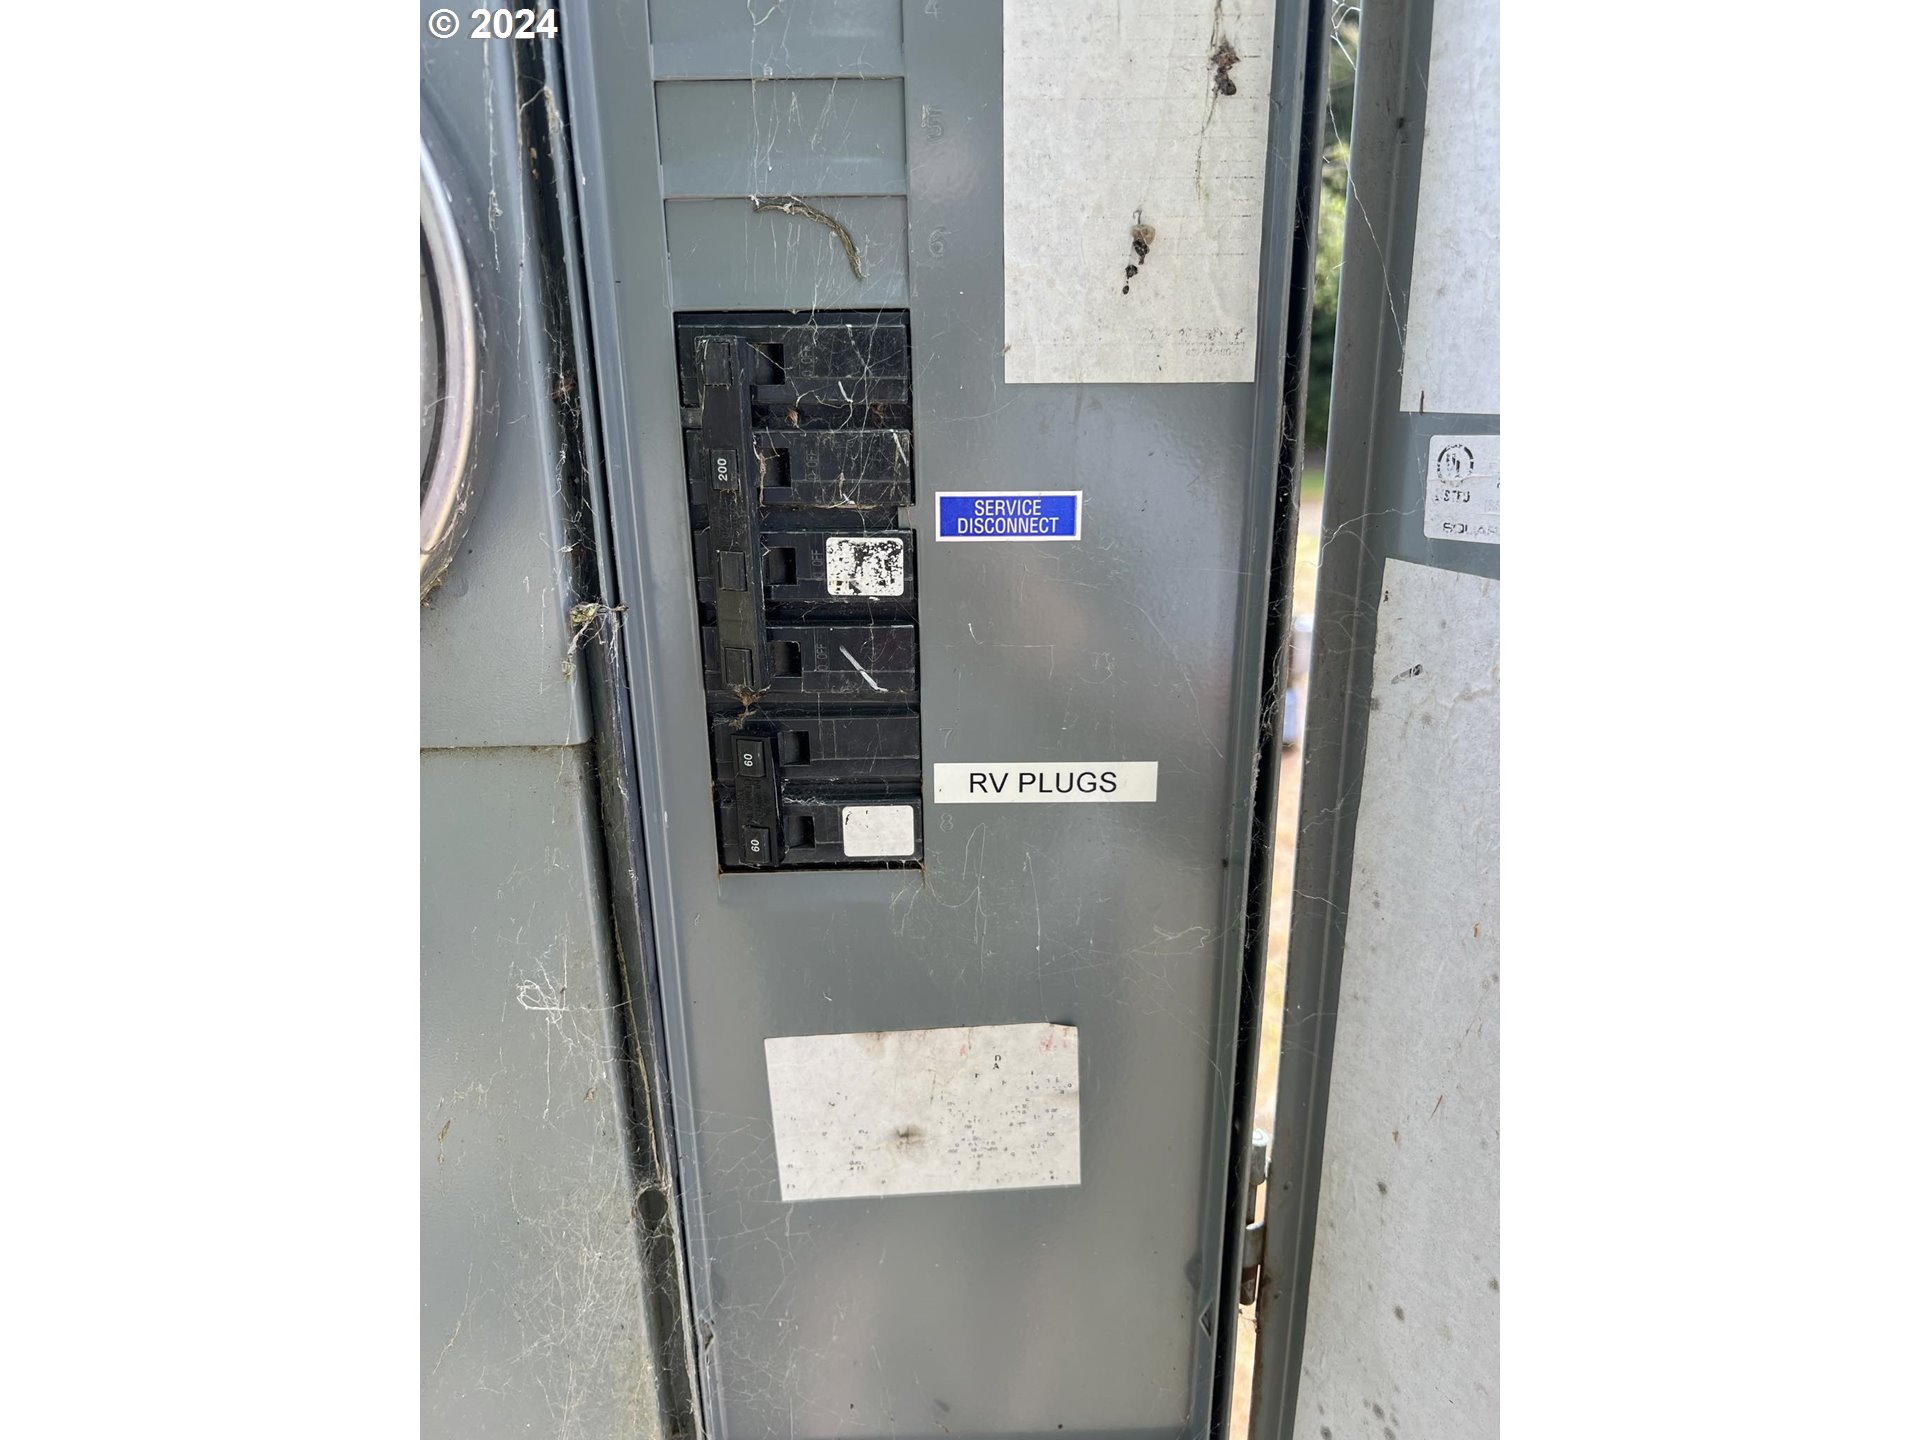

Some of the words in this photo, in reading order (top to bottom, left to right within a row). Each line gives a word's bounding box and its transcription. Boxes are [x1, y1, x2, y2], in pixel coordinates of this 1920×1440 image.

[717, 457, 729, 482] 200
[974, 499, 1042, 516] SERVICE
[957, 517, 1060, 534] DISCONNECT
[811, 549, 824, 567] OFF
[938, 727, 954, 748] 7
[743, 753, 754, 767] 60
[969, 772, 1009, 794] RV
[1018, 771, 1118, 794] PLUGS
[939, 813, 953, 833] 8
[750, 839, 761, 853] 60
